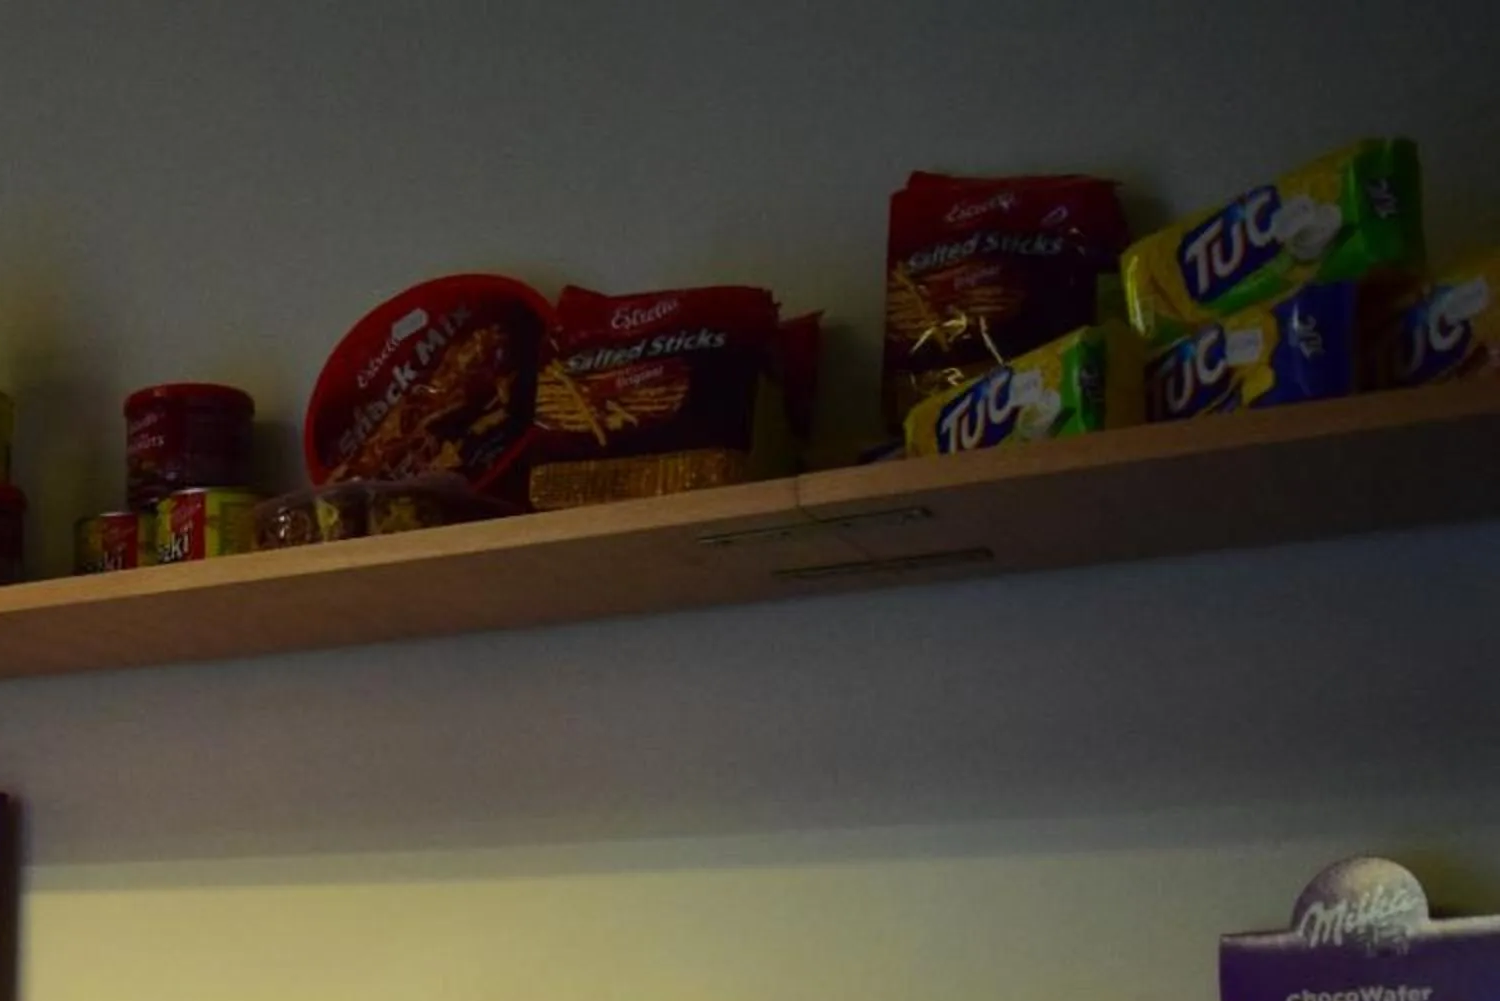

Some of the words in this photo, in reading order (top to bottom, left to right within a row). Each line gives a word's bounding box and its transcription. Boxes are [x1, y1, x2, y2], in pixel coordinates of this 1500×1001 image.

[1184, 190, 1283, 293] TUC
[338, 360, 419, 456] Snack
[414, 301, 472, 367] Mix
[648, 326, 727, 357] Sticks
[939, 369, 1013, 454] TUC
[1300, 886, 1420, 948] Milka
